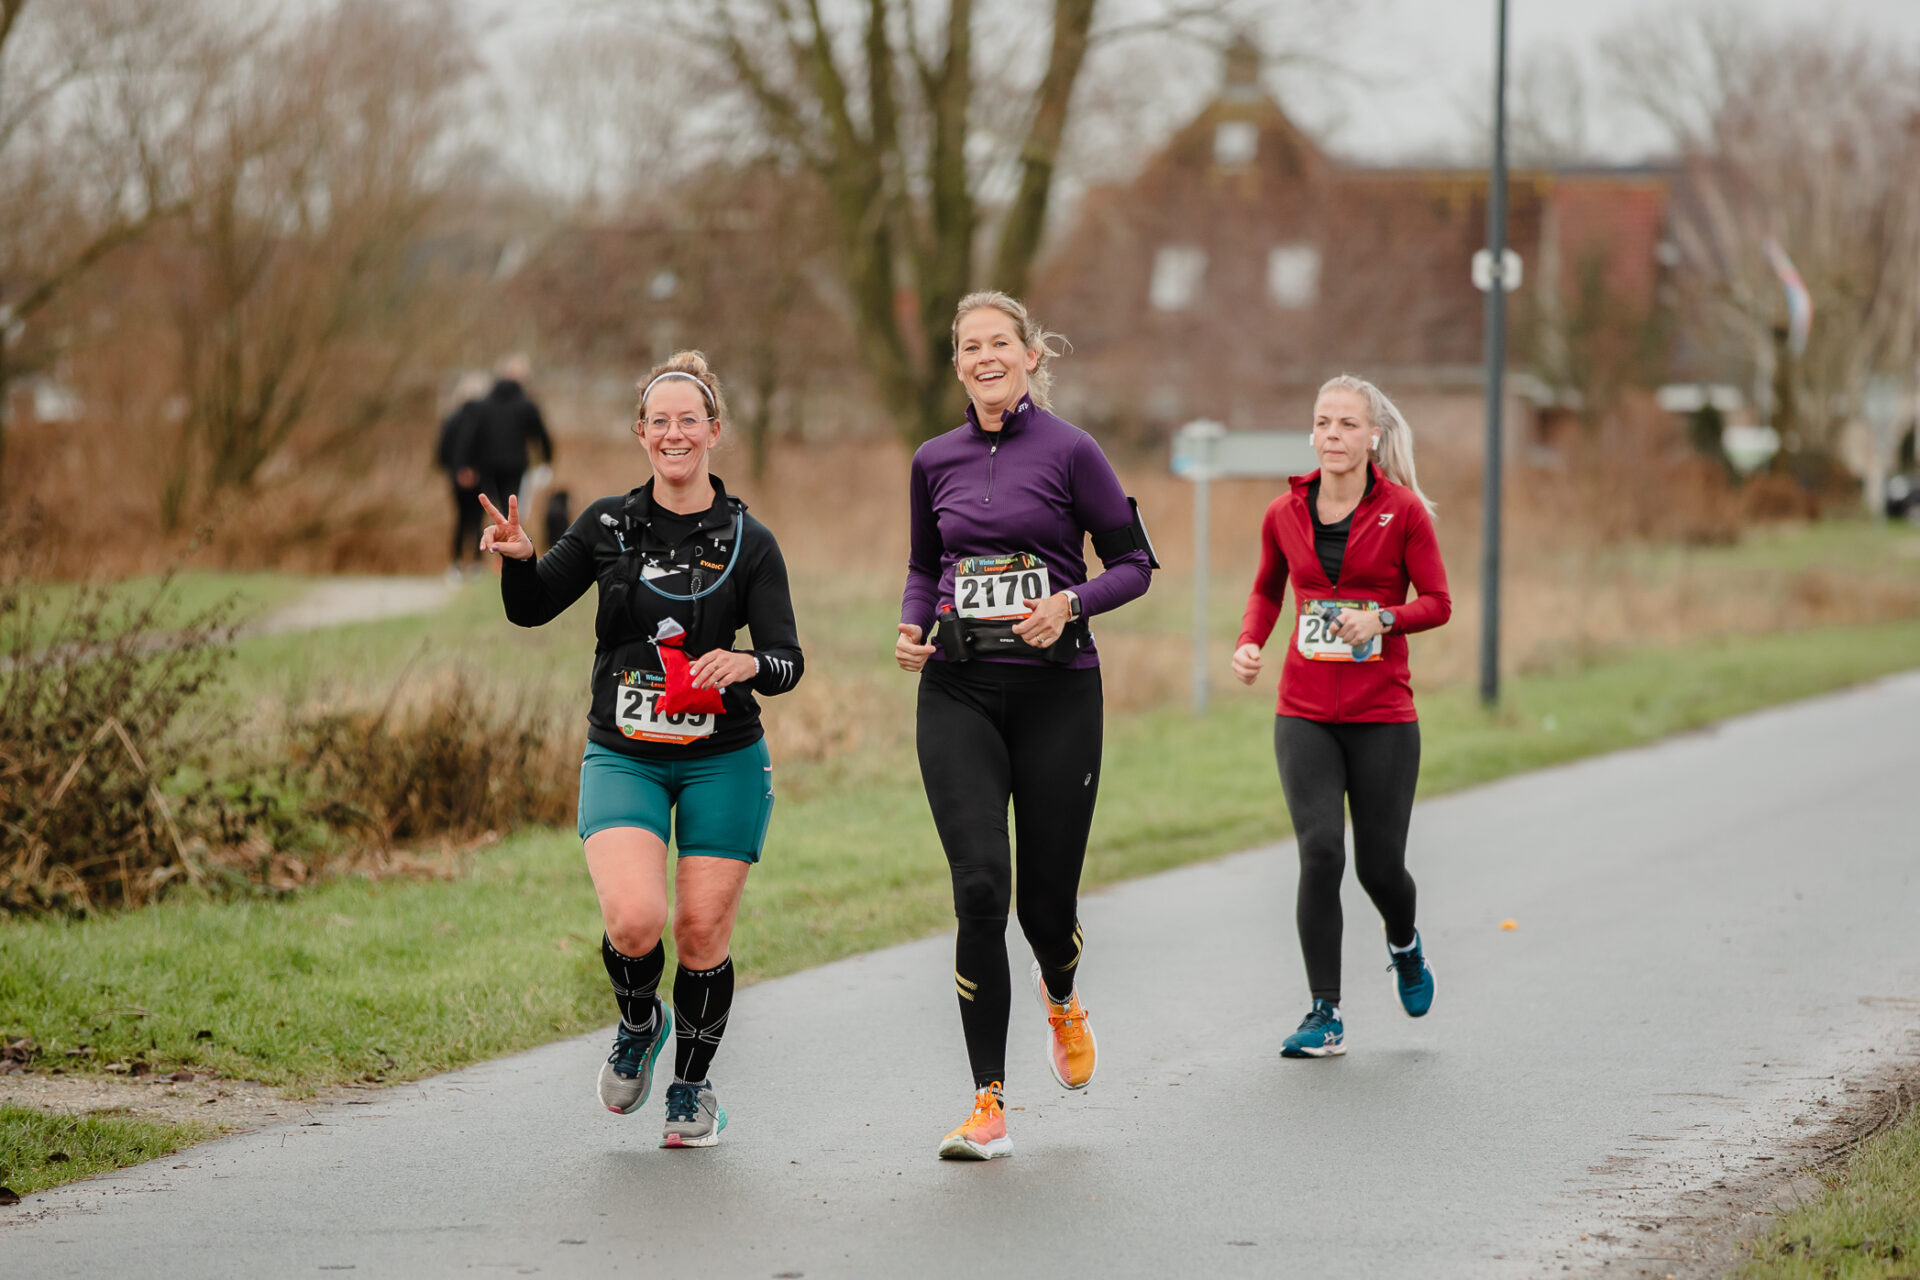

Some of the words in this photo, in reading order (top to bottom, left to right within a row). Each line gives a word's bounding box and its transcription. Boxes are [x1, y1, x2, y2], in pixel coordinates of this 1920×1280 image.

[962, 572, 1042, 609] 2170
[624, 671, 641, 685] WM
[645, 674, 664, 682] Winter
